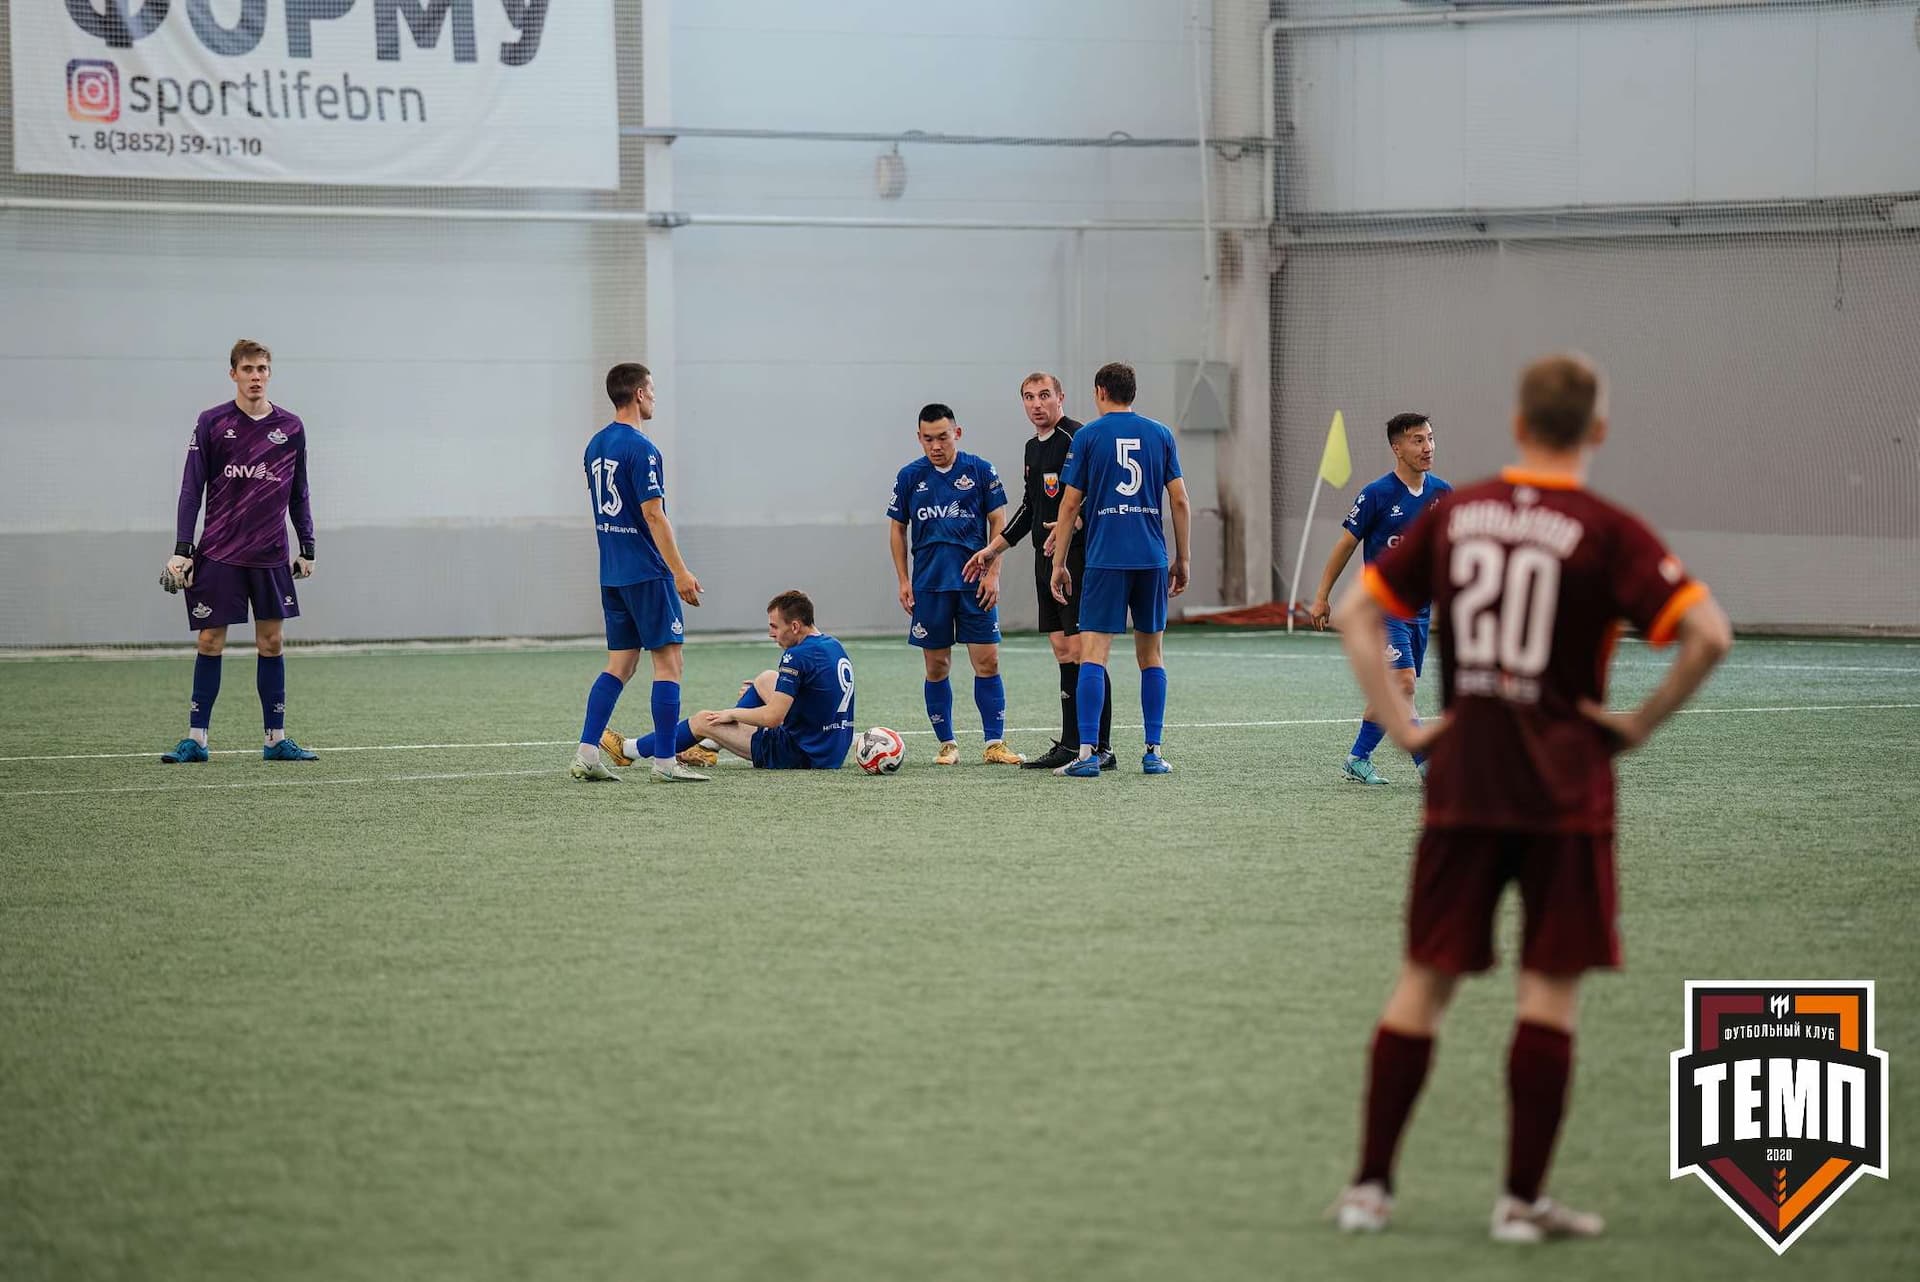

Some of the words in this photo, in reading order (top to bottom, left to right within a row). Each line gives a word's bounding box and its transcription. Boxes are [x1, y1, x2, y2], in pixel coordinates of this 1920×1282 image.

[128, 69, 427, 126] sportlifebrn
[94, 130, 175, 157] 8(3852)
[180, 134, 262, 156] 59-11-10
[224, 464, 256, 478] GNV
[591, 457, 623, 517] 13
[1115, 438, 1142, 496] 5
[917, 505, 948, 520] GNV
[1450, 540, 1562, 674] 20
[837, 657, 855, 713] 9
